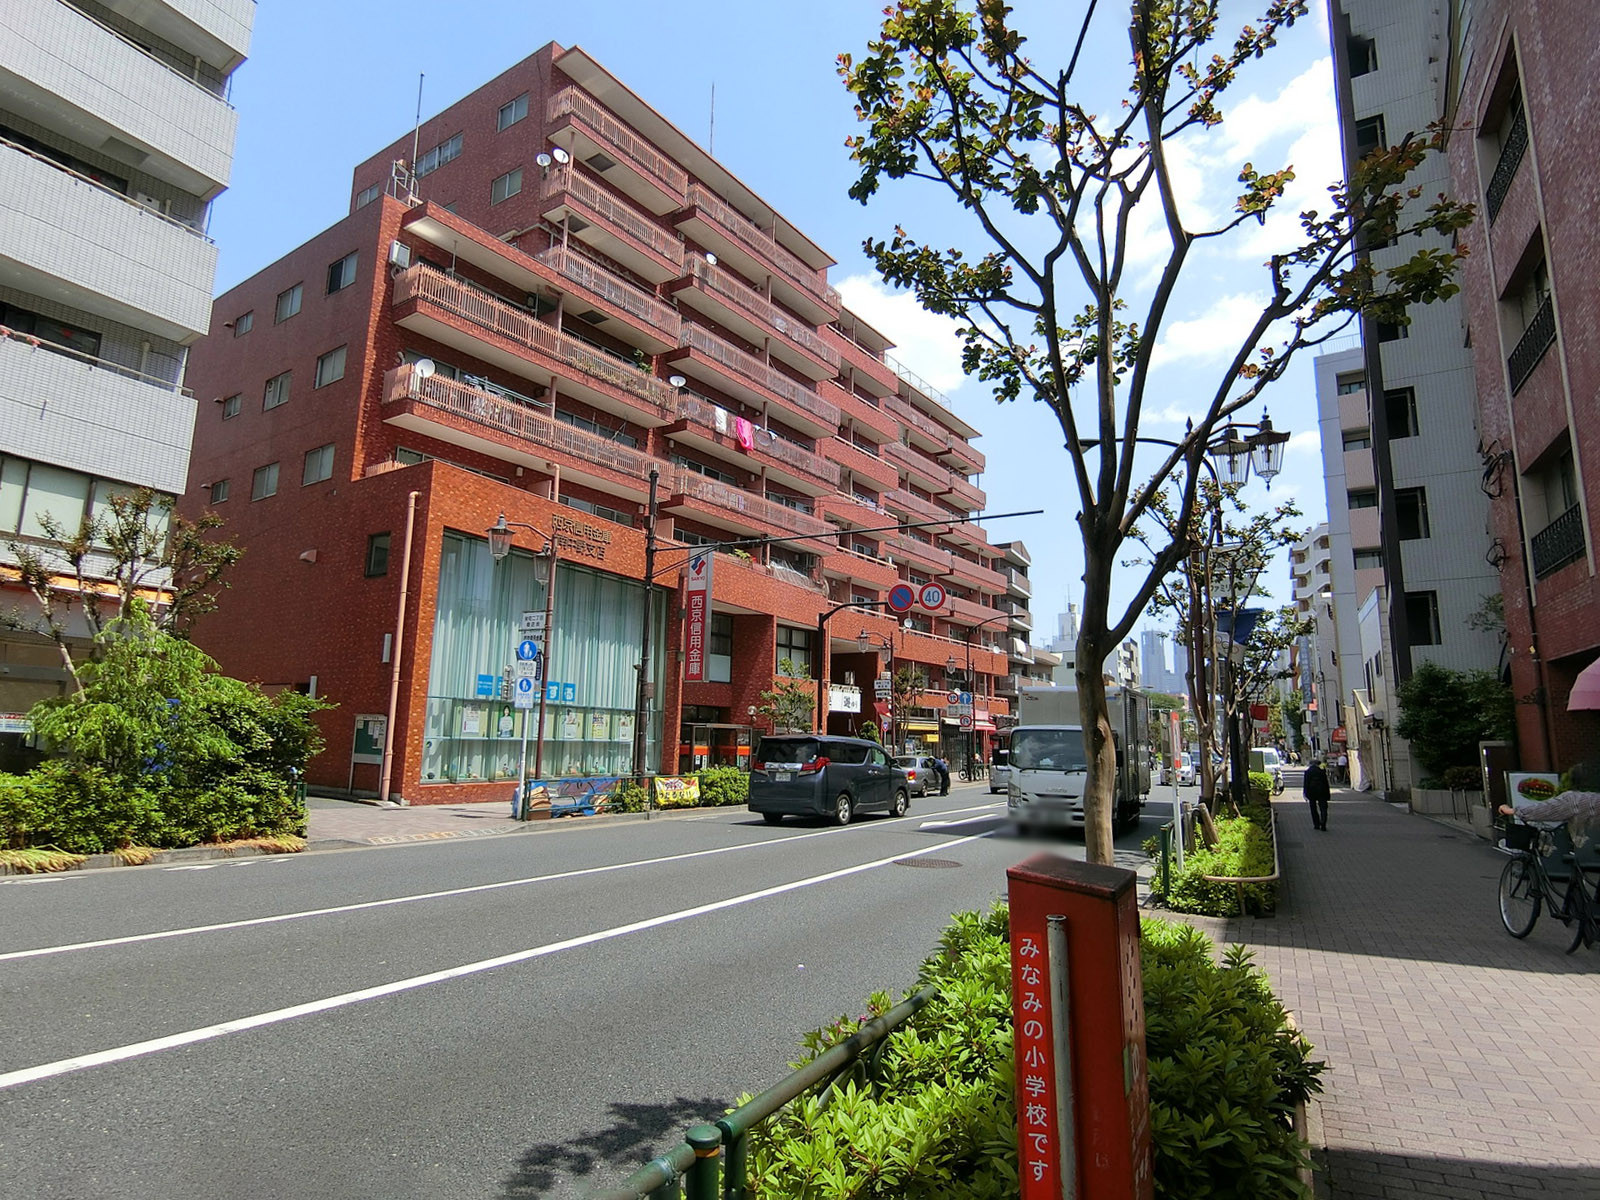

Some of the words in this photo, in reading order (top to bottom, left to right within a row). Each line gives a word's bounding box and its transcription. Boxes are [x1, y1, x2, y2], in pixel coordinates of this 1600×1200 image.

[552, 513, 611, 544] 西京信用金庫
[925, 590, 940, 603] 40
[689, 595, 703, 675] 西京信用金庫
[1019, 938, 1049, 1182] みなみの小学校です
